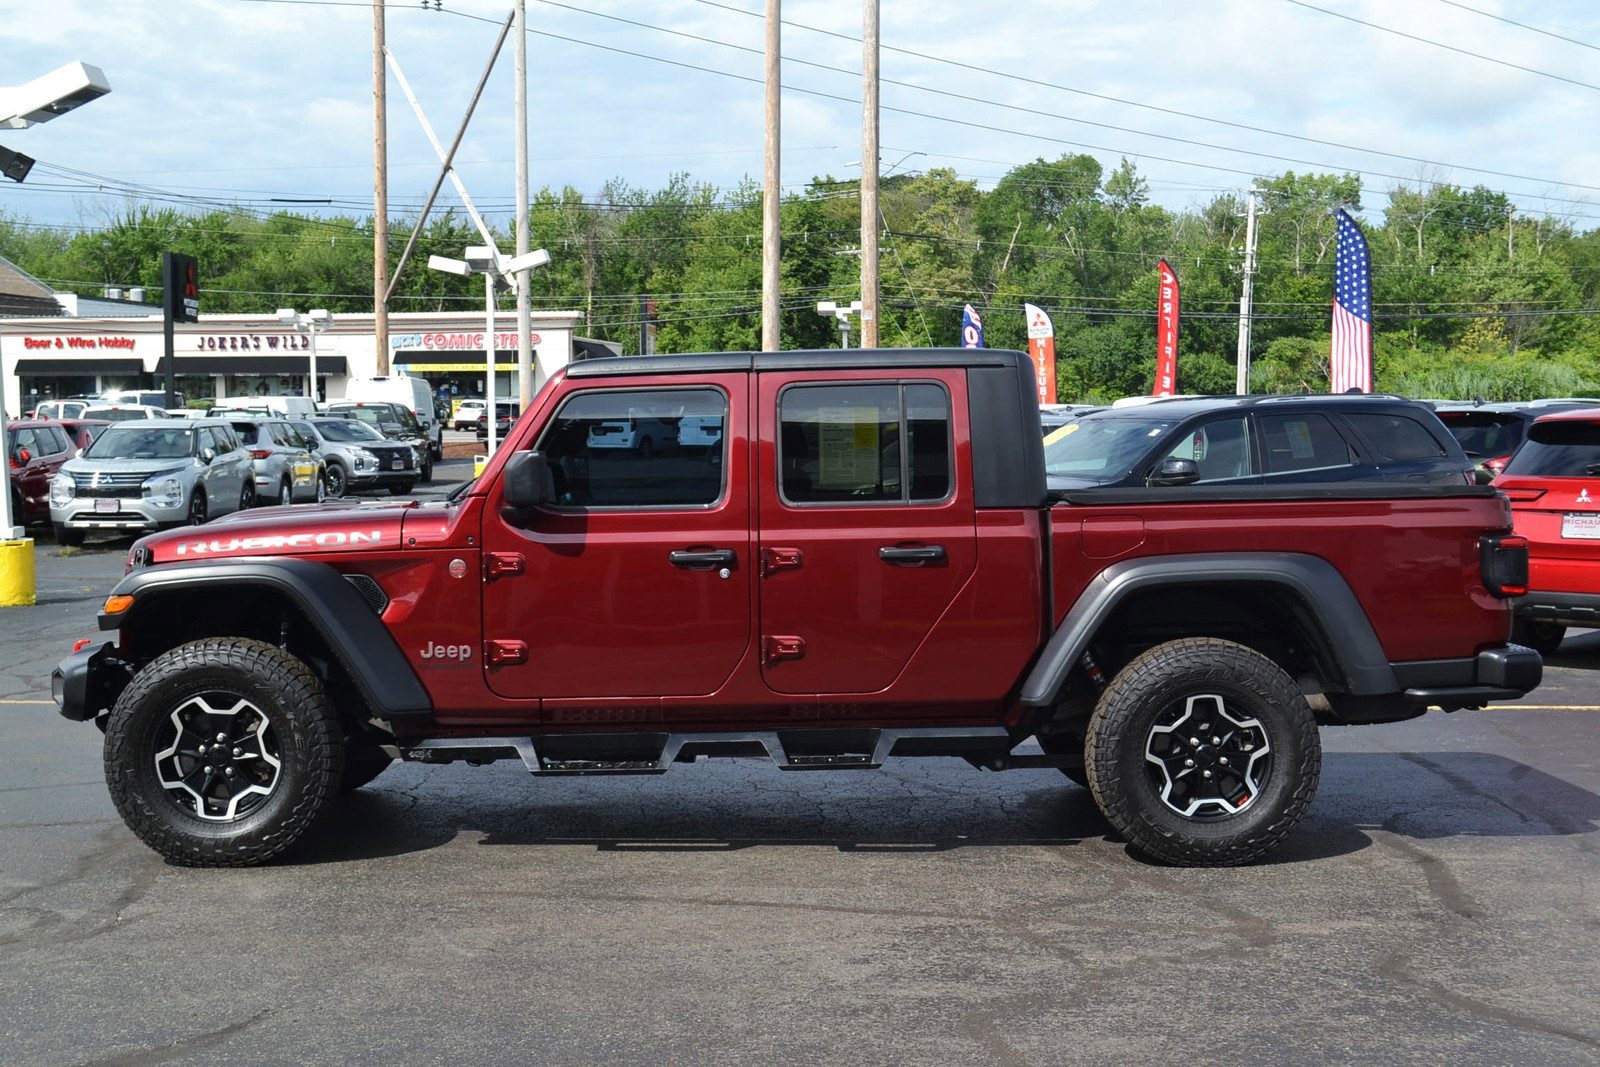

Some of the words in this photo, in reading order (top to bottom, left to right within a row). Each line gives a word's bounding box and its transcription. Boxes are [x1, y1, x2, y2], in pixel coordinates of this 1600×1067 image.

[24, 336, 52, 349] Beer
[54, 337, 64, 349] &
[66, 336, 96, 349] Wine
[98, 336, 136, 351] Hobby
[197, 334, 261, 349] JOKER'S
[266, 334, 310, 349] WILD
[423, 333, 484, 349] COMIC
[176, 530, 381, 555] RUBICON
[420, 641, 472, 662] Jeep
